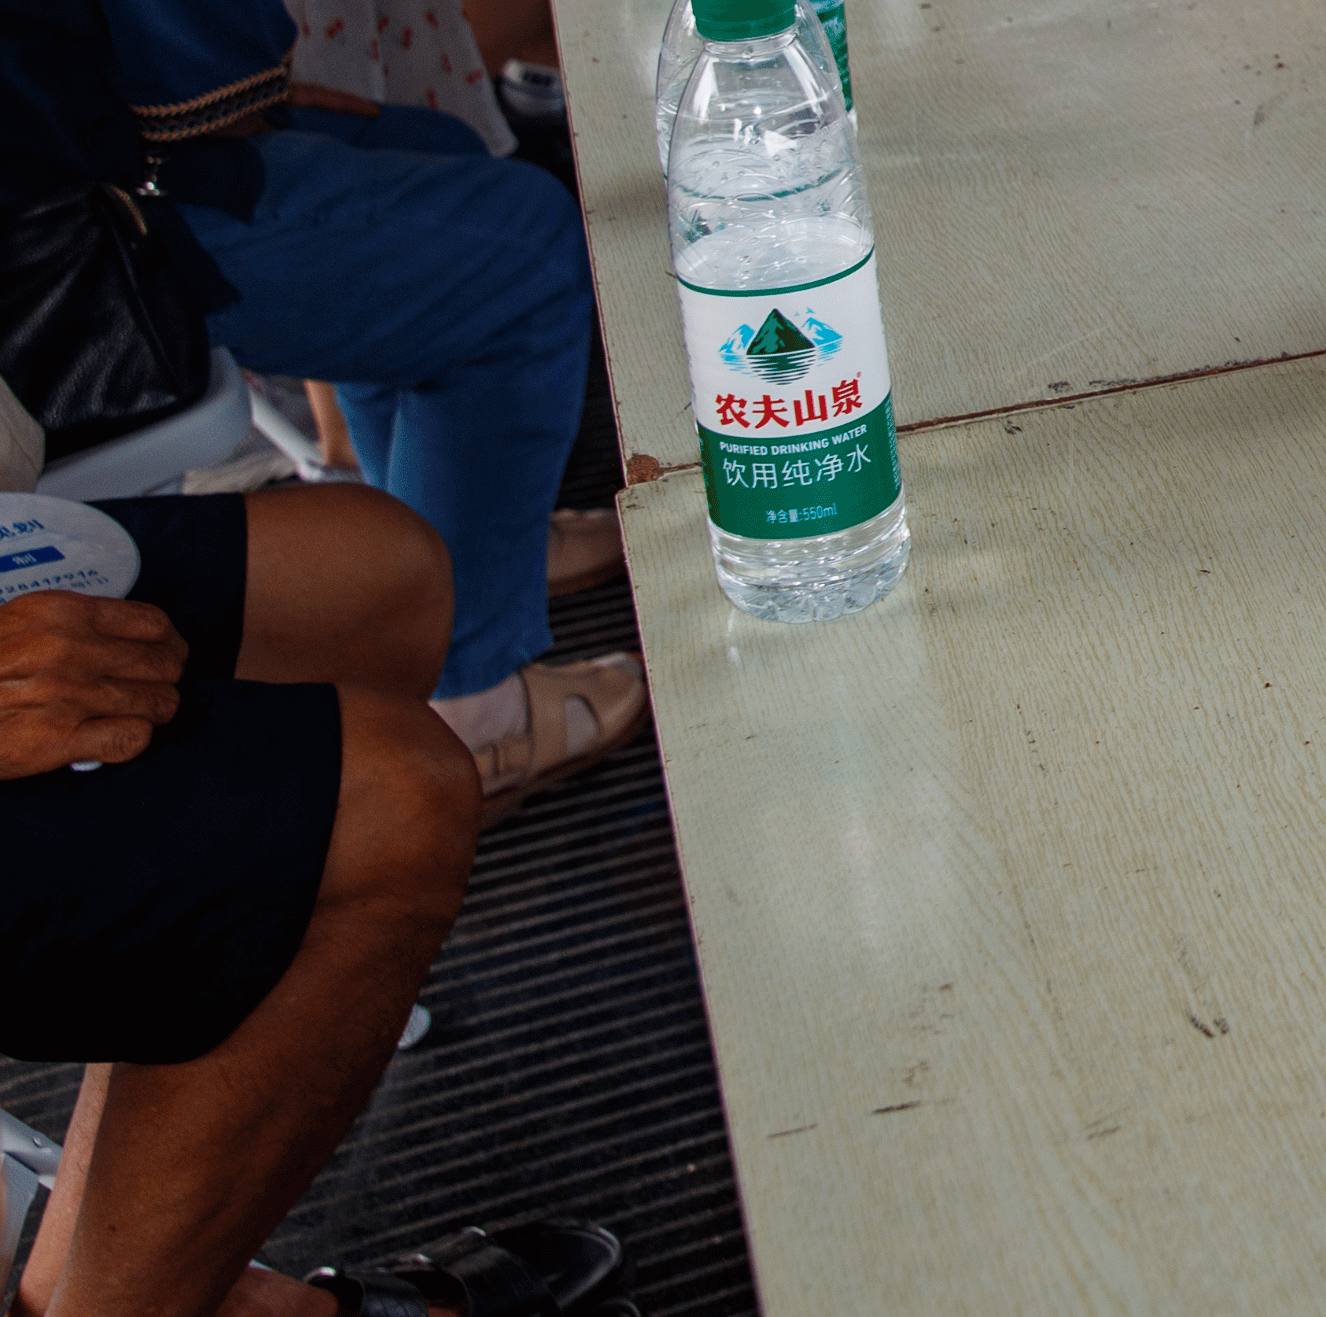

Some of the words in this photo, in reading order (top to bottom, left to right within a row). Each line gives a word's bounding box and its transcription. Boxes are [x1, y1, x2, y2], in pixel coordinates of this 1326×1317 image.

[715, 379, 863, 429] 农夫山泉
[719, 441, 768, 456] PURIFIED
[771, 438, 829, 455] DRINKING
[831, 424, 867, 446] WATER
[722, 443, 872, 489] 饮用纯净水
